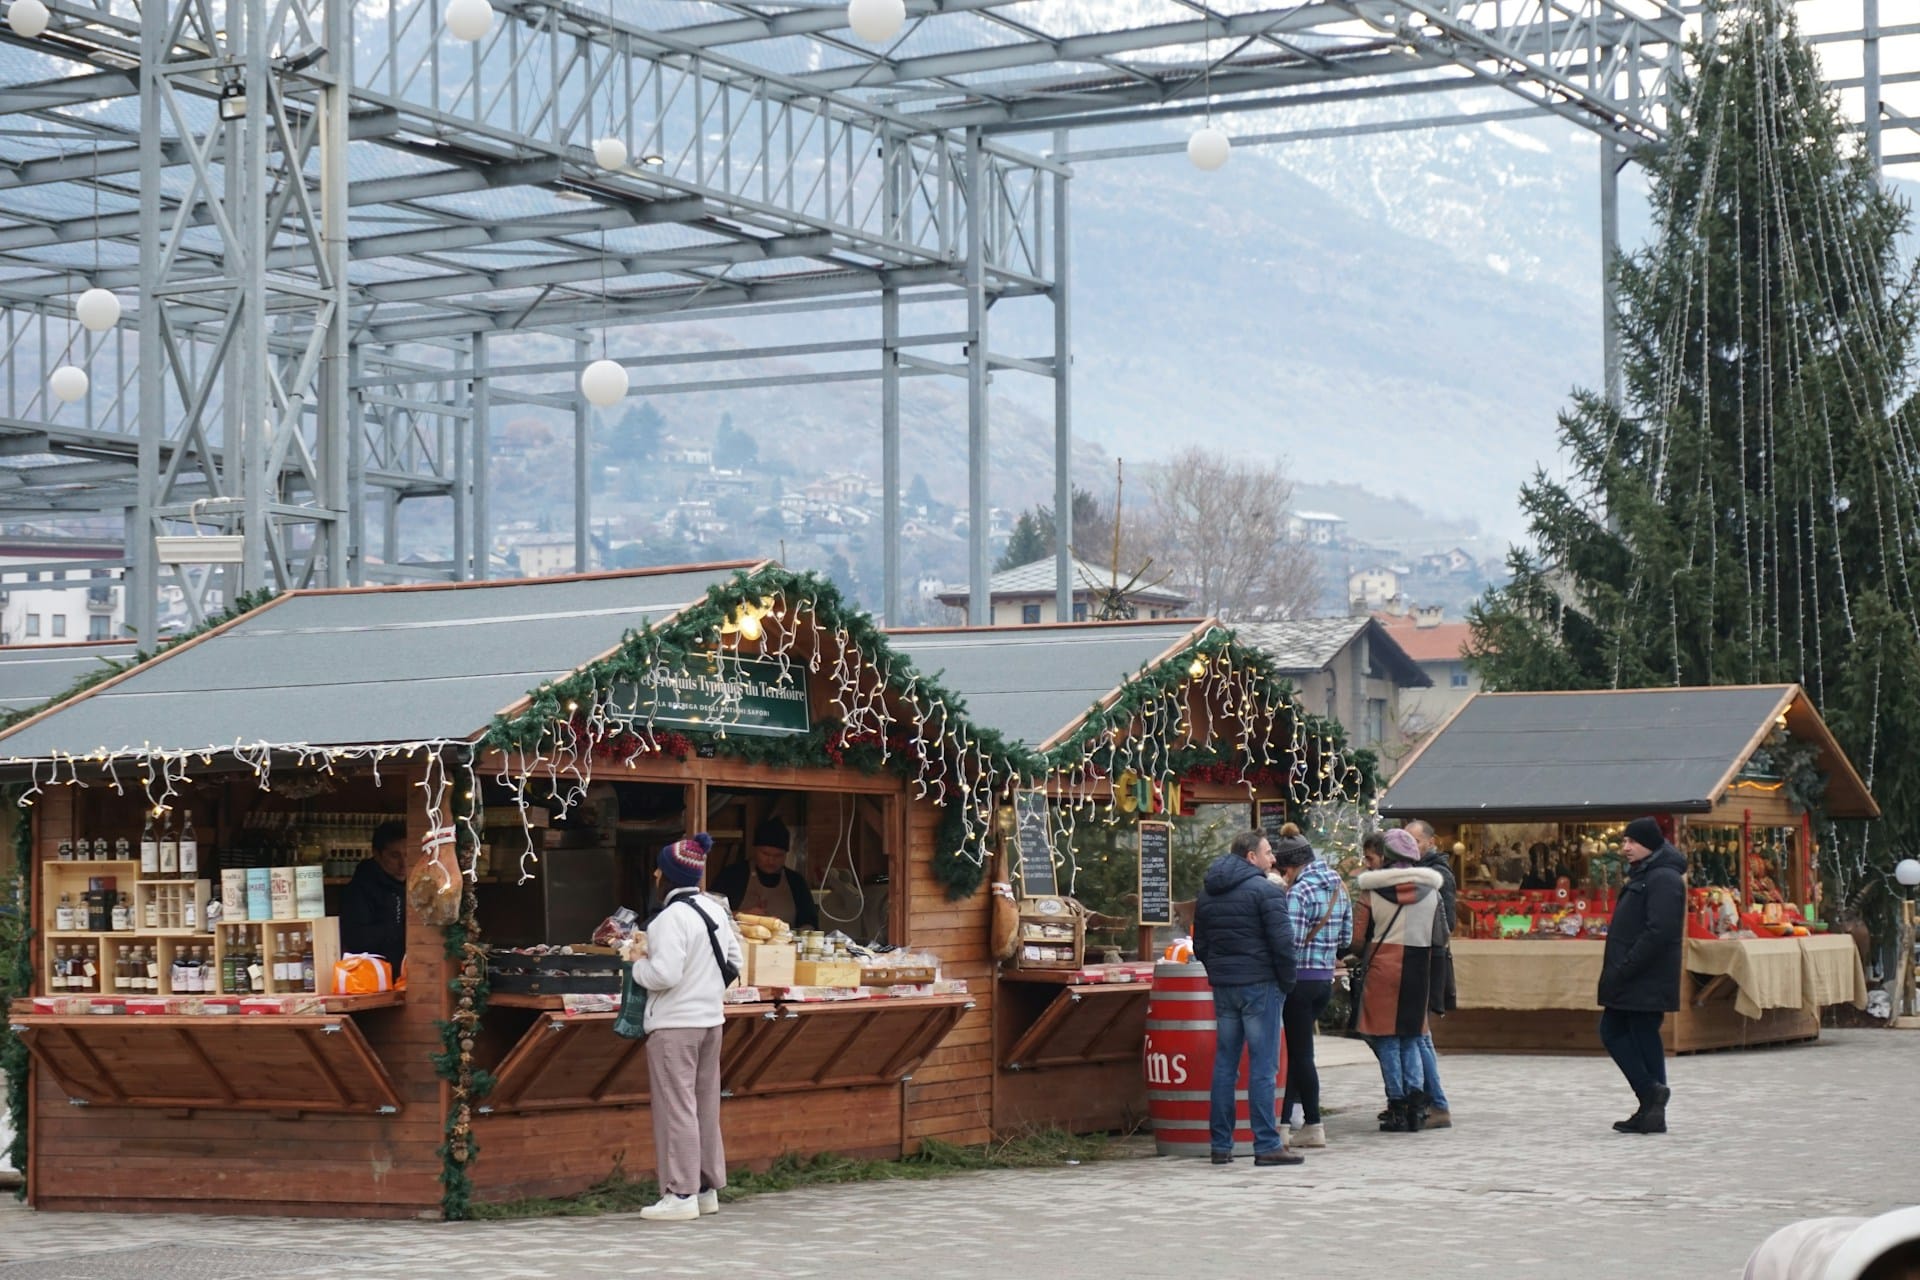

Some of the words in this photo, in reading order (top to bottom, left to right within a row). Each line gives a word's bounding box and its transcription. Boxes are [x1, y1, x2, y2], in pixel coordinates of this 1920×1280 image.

[745, 680, 759, 696] du
[747, 709, 771, 717] SAPORI
[1116, 770, 1195, 816] CUISINE
